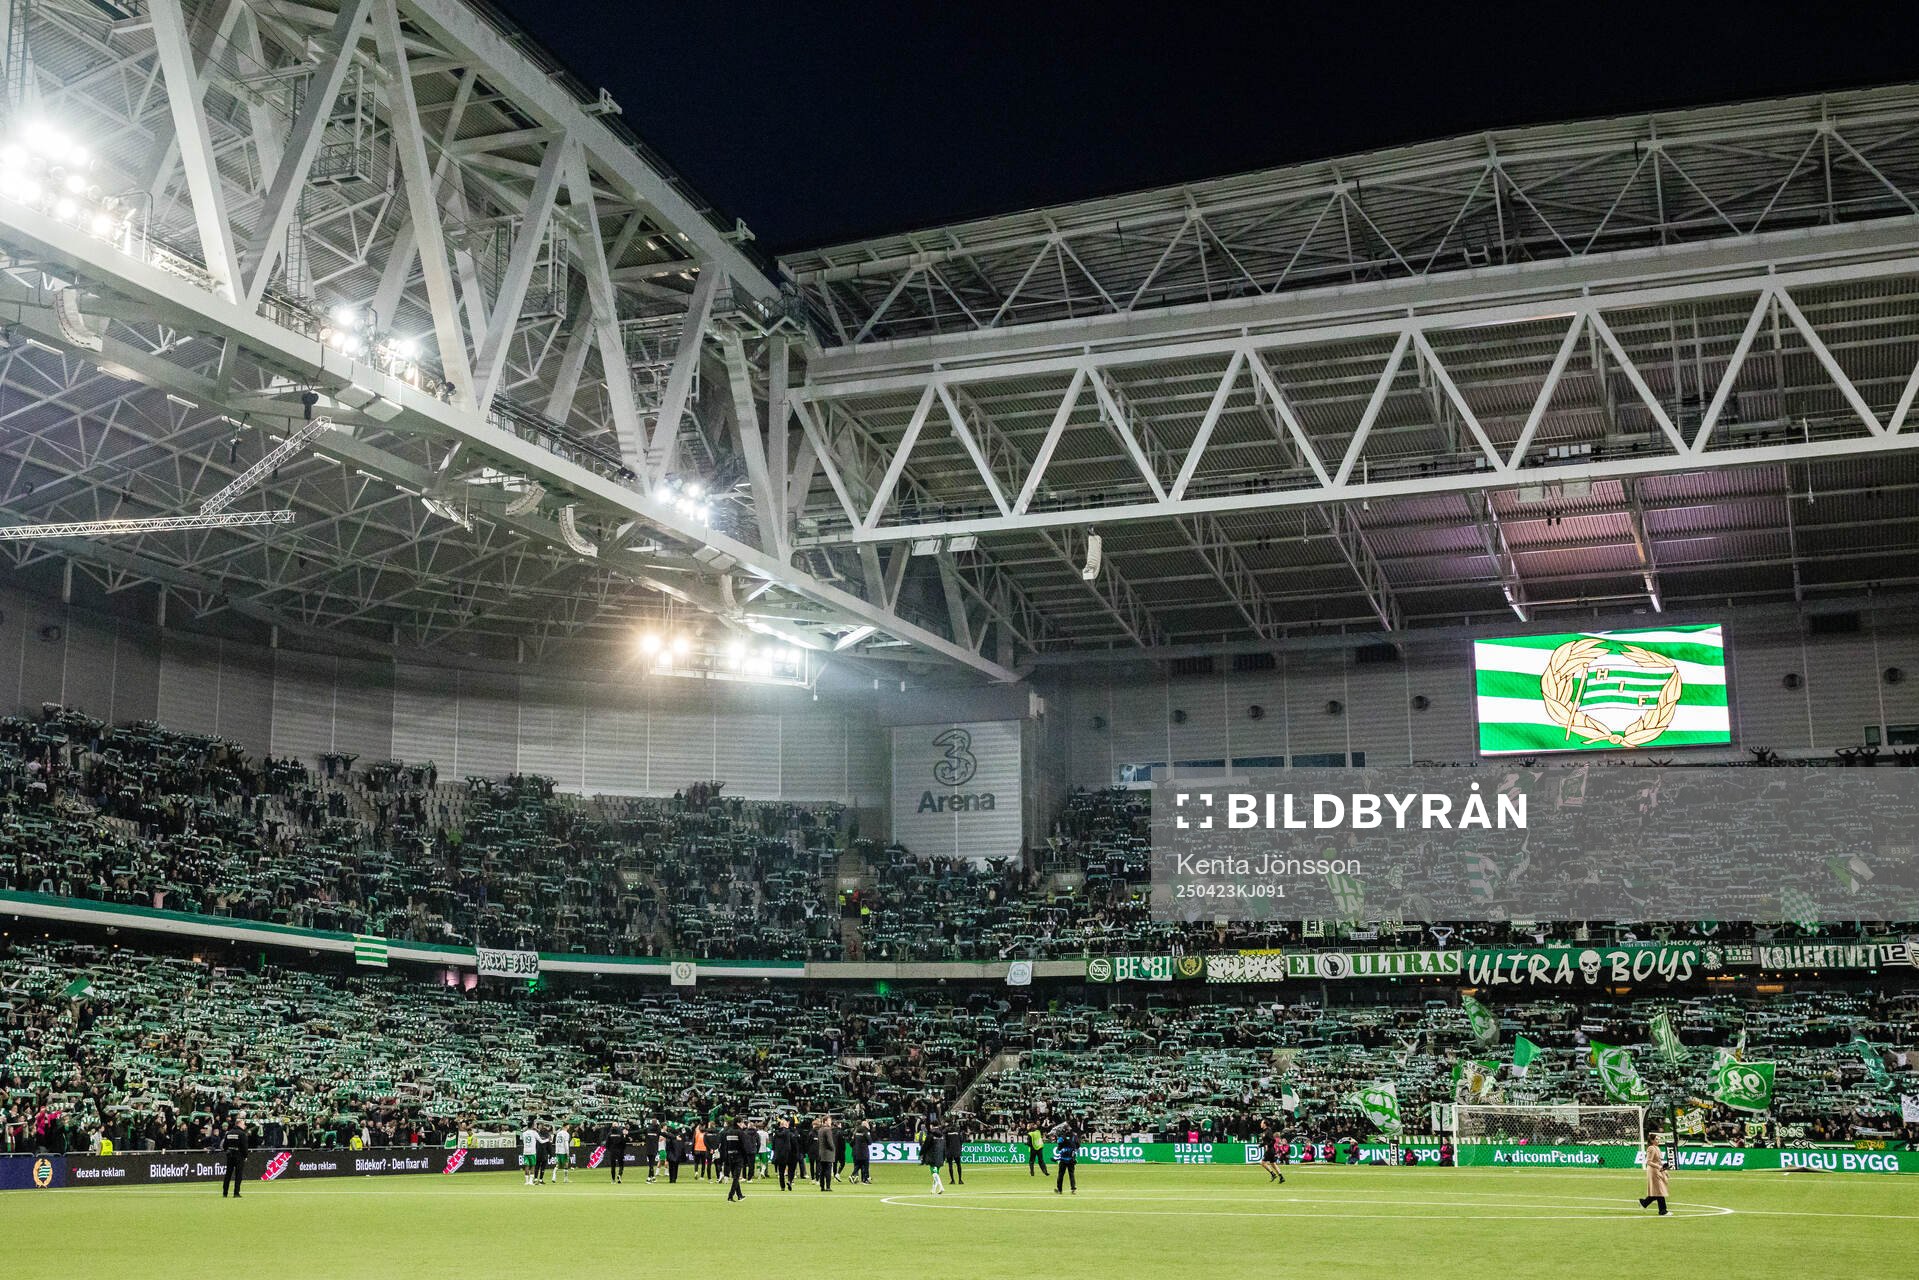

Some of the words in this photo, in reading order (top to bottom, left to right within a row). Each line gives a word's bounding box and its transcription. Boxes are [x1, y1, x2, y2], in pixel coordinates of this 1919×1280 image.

[917, 790, 995, 813] Arena
[1881, 945, 1906, 961] 12
[479, 951, 507, 971] GREEN
[512, 953, 538, 974] BOYS
[1351, 951, 1458, 975] ULTRAS
[1468, 952, 1574, 985] ULTRA
[1606, 948, 1696, 982] BOYS
[1174, 1143, 1212, 1152] BIBLIO
[355, 1158, 387, 1171] Bildekor?
[392, 1159, 404, 1169] Den
[406, 1158, 420, 1169] fixar
[1011, 1154, 1025, 1162] AB
[1174, 1155, 1213, 1164] TEKET
[1719, 1152, 1745, 1166] AB
[1780, 1152, 1837, 1170] RUGU
[1842, 1153, 1899, 1171] BYGG
[76, 1167, 99, 1178] dezeta
[101, 1166, 125, 1177] reklam
[150, 1164, 188, 1178] Bildekor?
[197, 1163, 213, 1176] Den
[299, 1162, 317, 1170] dezeta
[318, 1162, 336, 1170] reklam
